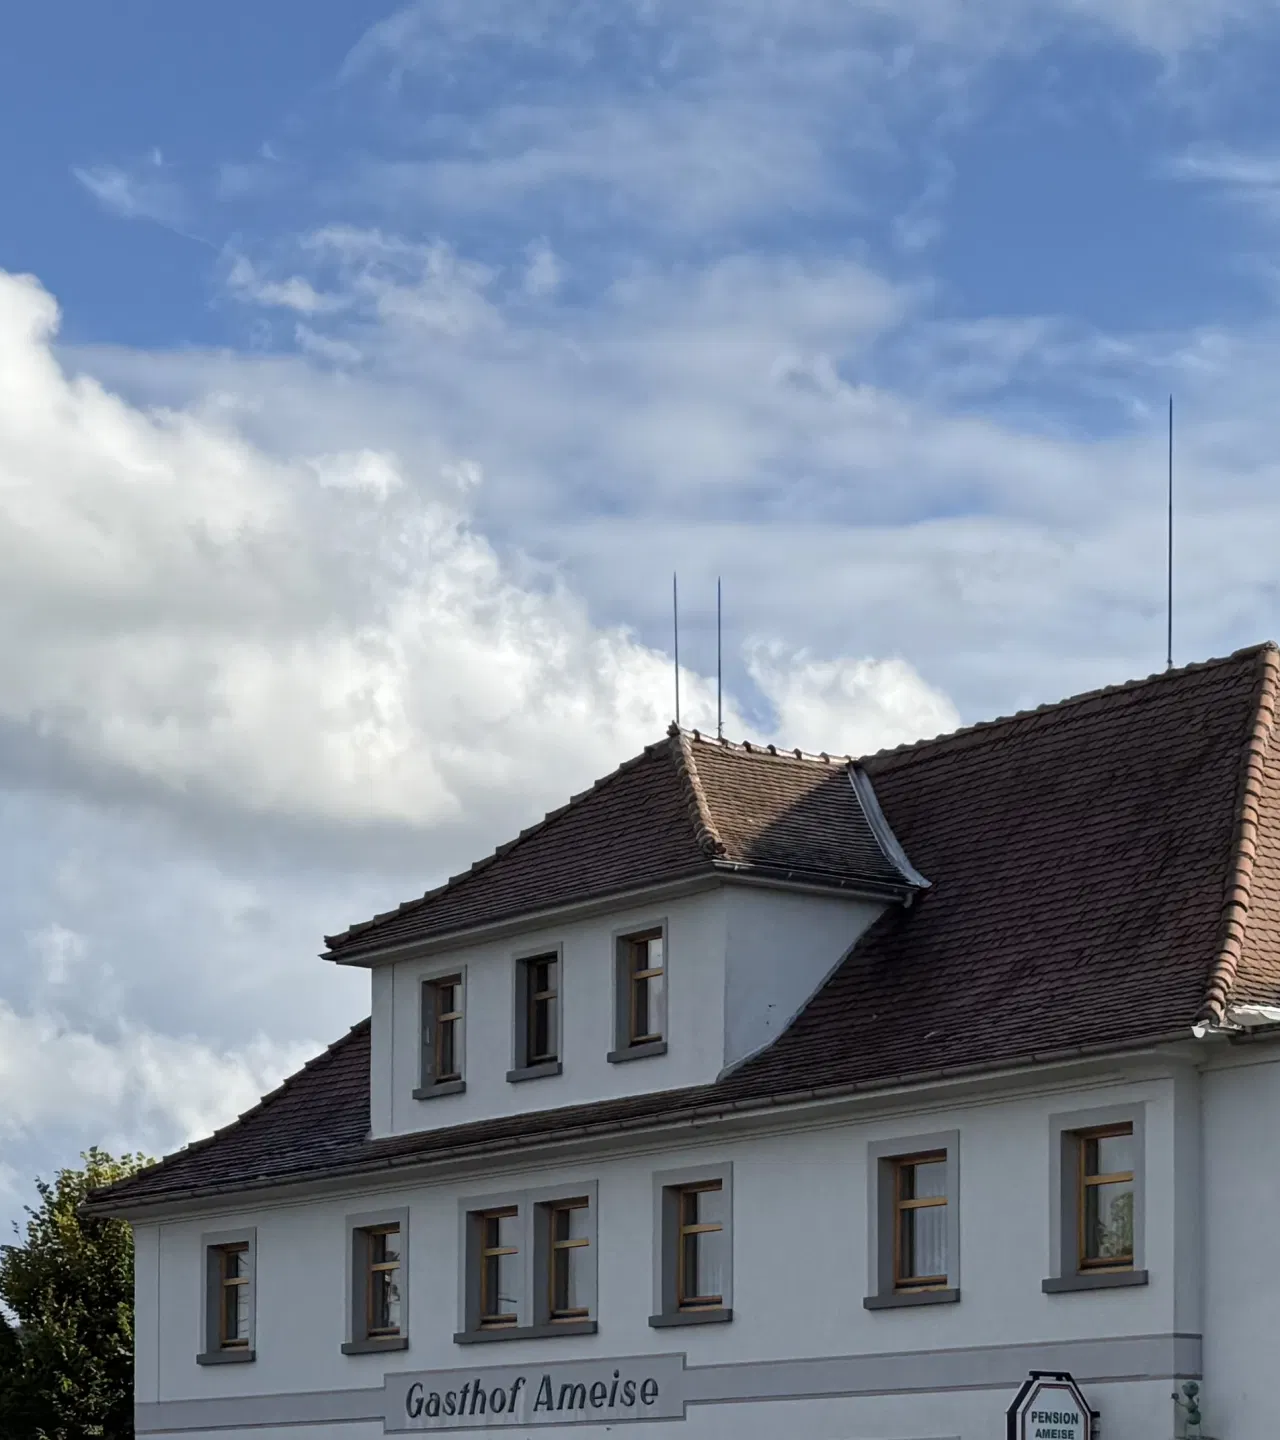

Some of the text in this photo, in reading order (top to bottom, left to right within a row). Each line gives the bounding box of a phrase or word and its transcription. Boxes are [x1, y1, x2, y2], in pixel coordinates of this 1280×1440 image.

[405, 1369, 660, 1418] Gasthof Ameise
[1031, 1411, 1079, 1425] PENSION
[1035, 1428, 1075, 1440] AMEISE
